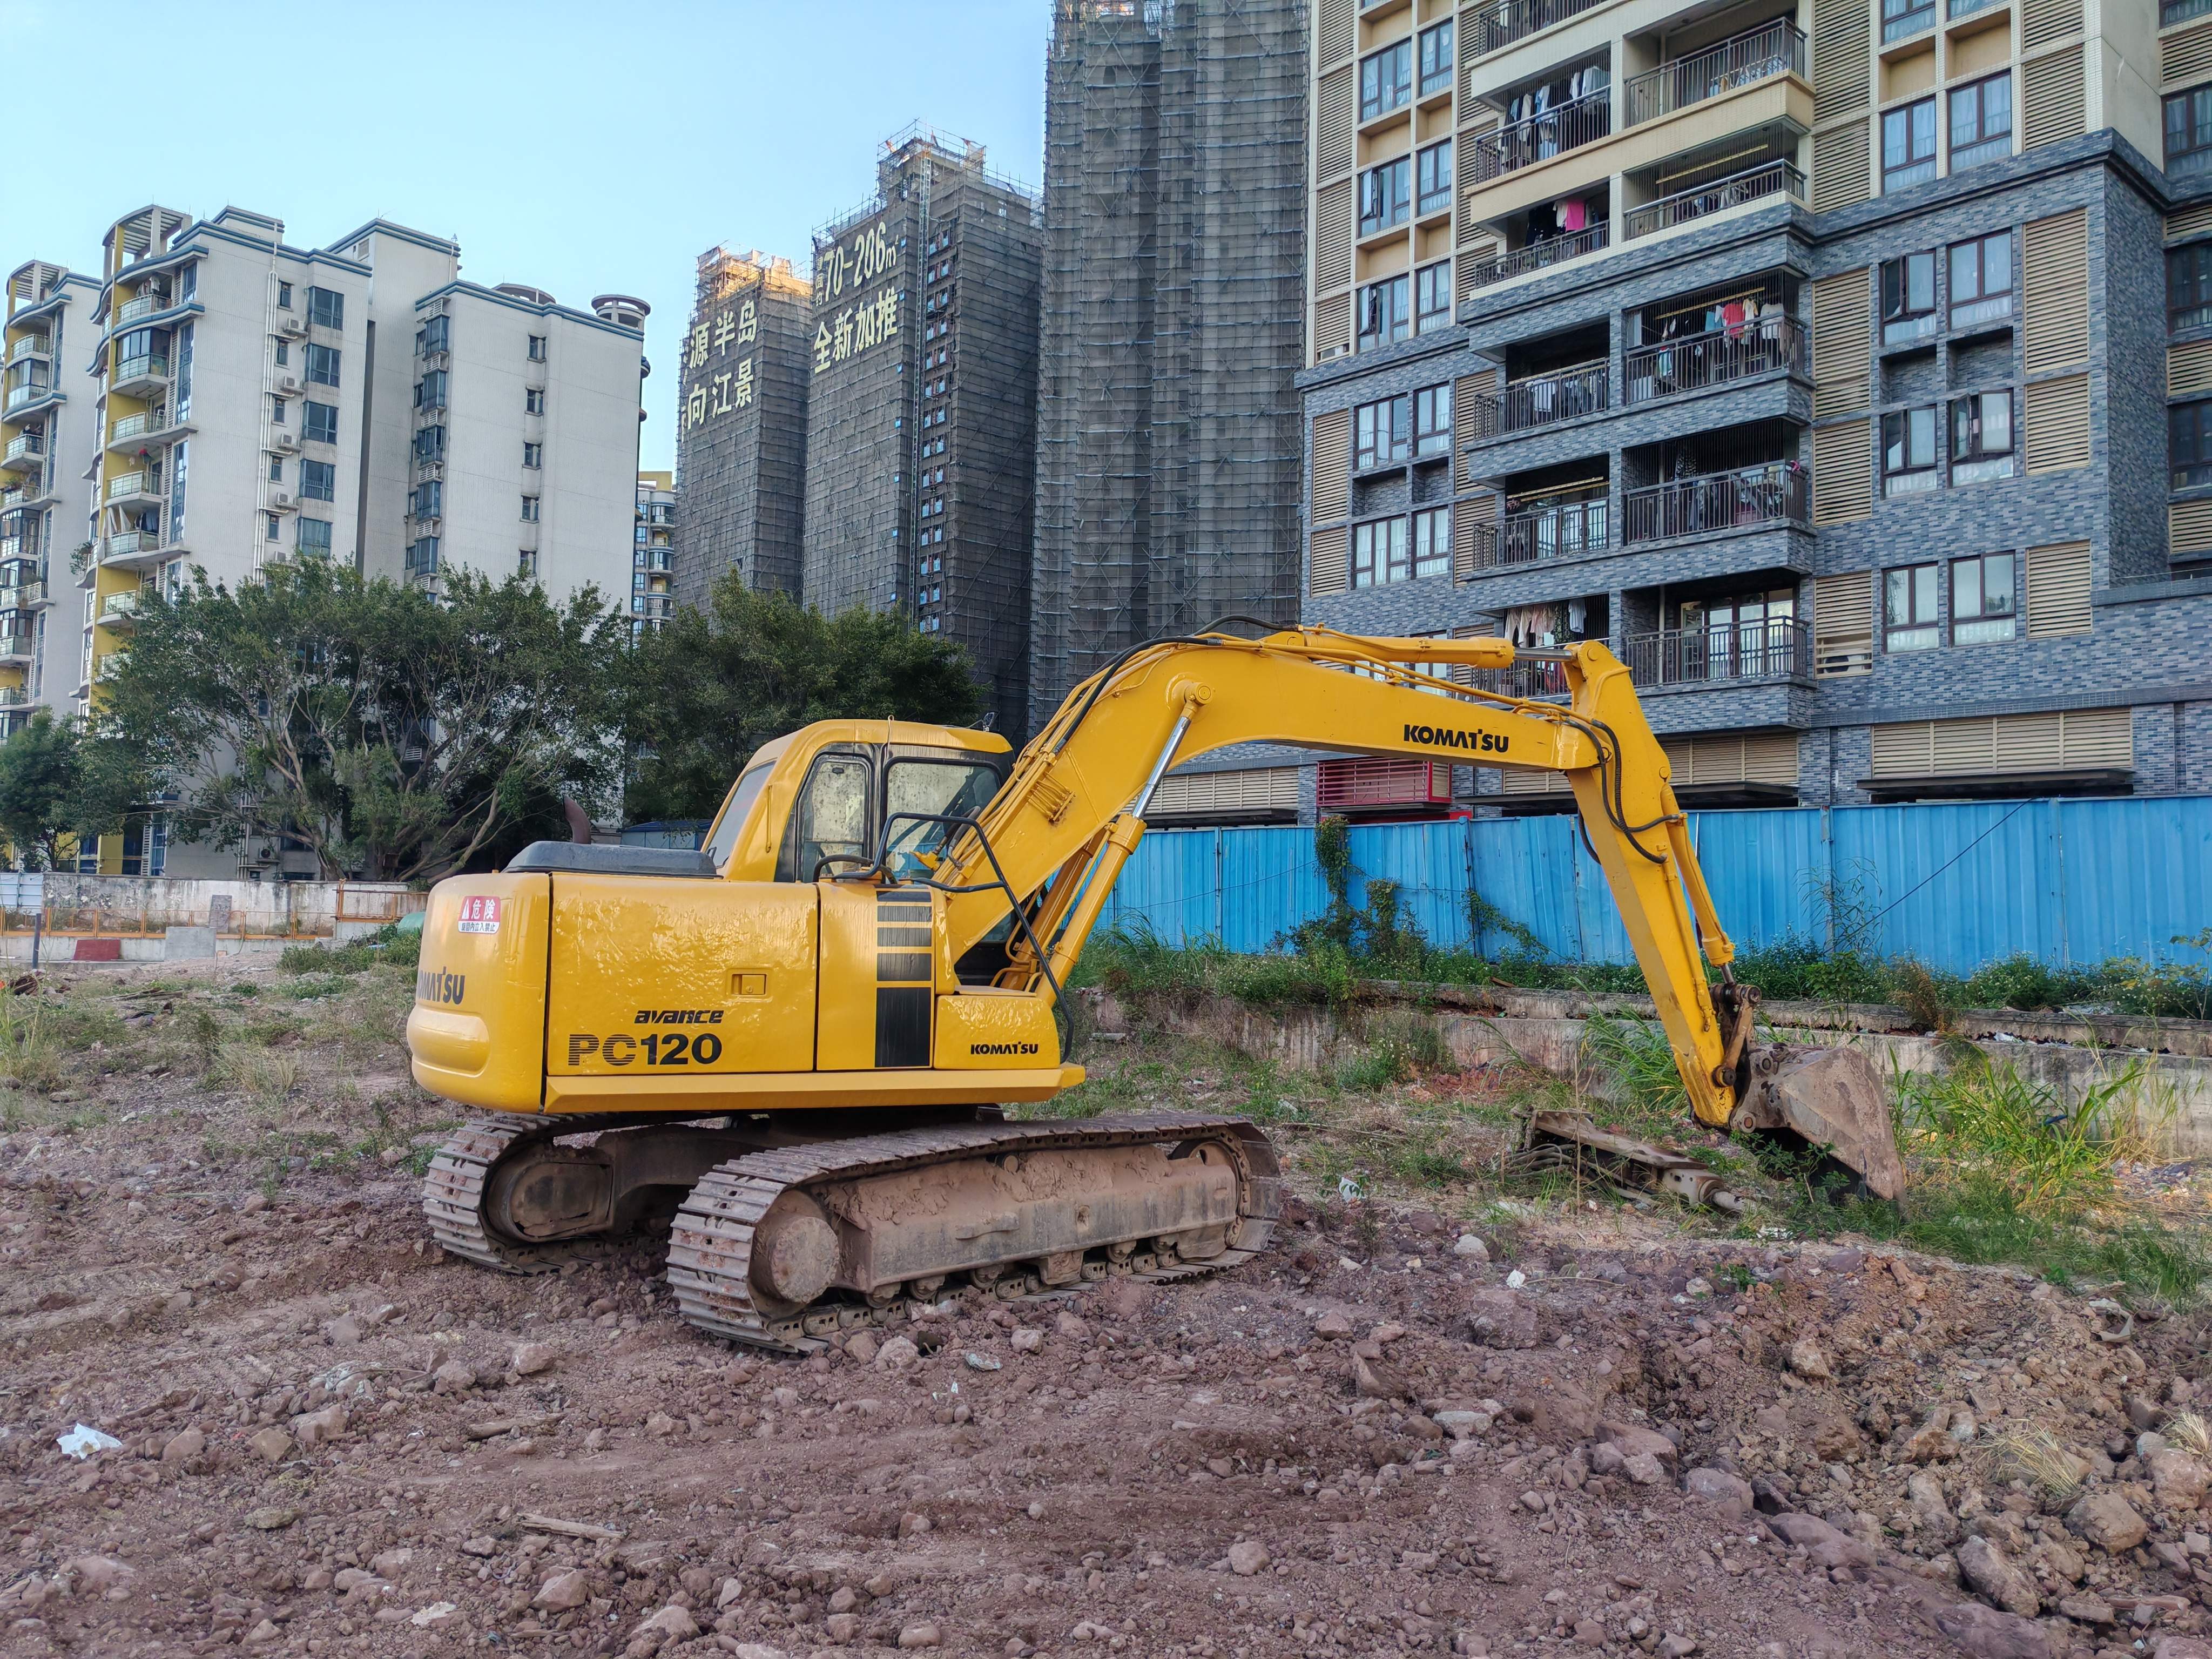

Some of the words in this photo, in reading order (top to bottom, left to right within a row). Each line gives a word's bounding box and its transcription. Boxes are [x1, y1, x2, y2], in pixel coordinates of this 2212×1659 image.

[683, 299, 757, 386] 源半岛
[814, 286, 898, 374] 全新加推
[681, 358, 754, 443] 向江景
[1404, 724, 1509, 753] KOMATSU
[417, 966, 466, 1004] OMATSU
[634, 1010, 724, 1024] avance
[568, 1033, 722, 1066] PC120
[970, 1041, 1038, 1055] KOMATSU
